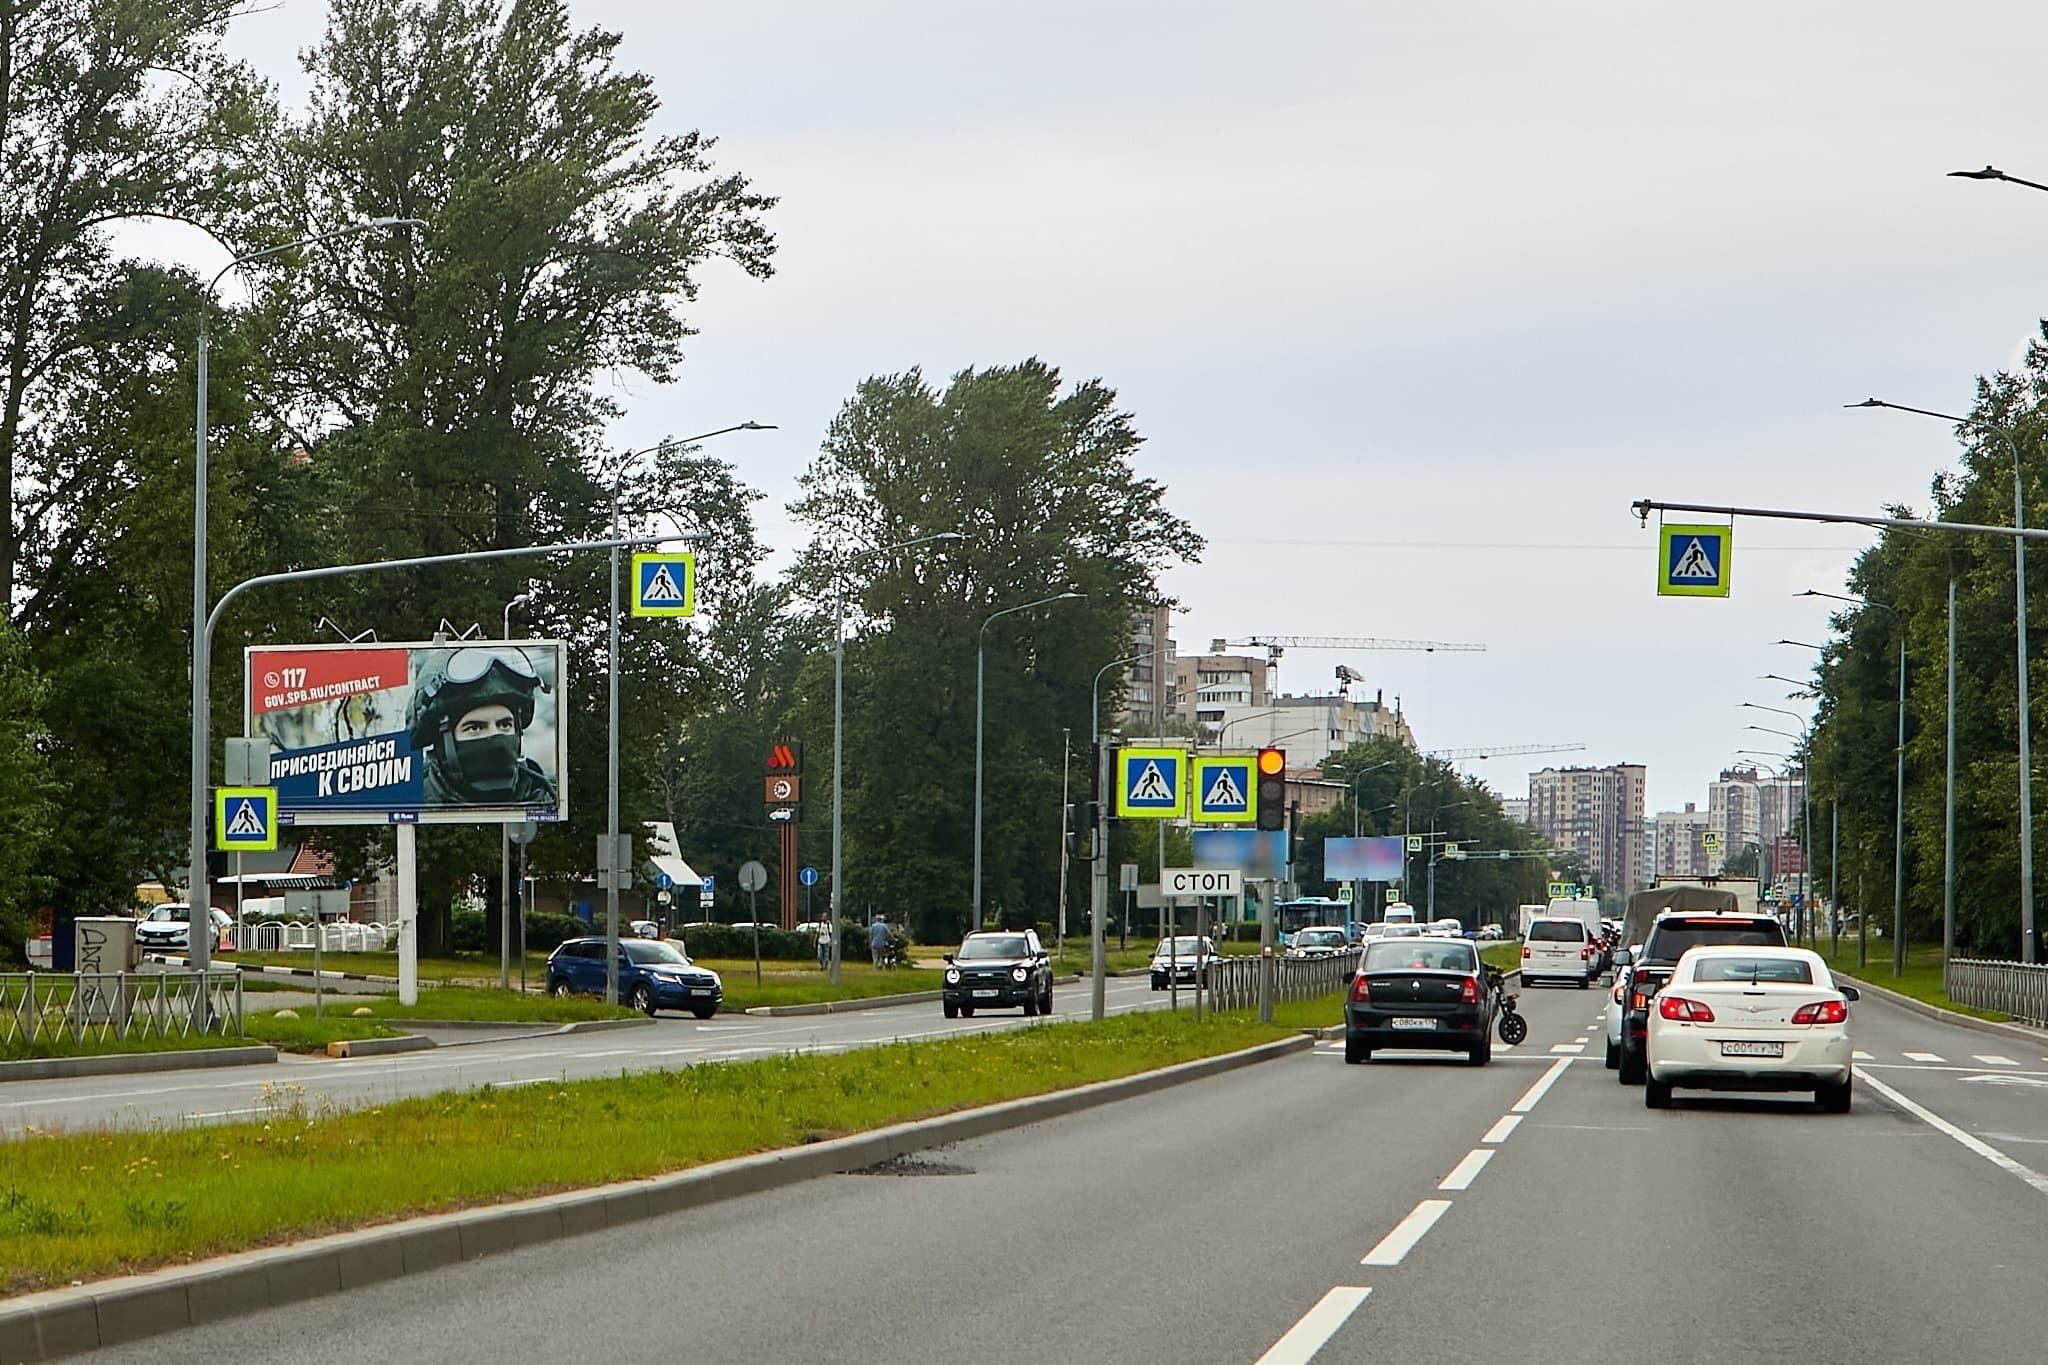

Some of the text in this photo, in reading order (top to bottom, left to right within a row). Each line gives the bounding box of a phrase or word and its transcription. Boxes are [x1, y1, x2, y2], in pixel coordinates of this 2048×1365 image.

[264, 675, 380, 708] GOV.SPB.RU/CONTRACT
[281, 668, 307, 689] 117
[271, 739, 396, 780] ПРИСОЕДИНЯЙСЯ
[318, 756, 412, 798] К СВОИМ
[1173, 873, 1230, 891] СТОП
